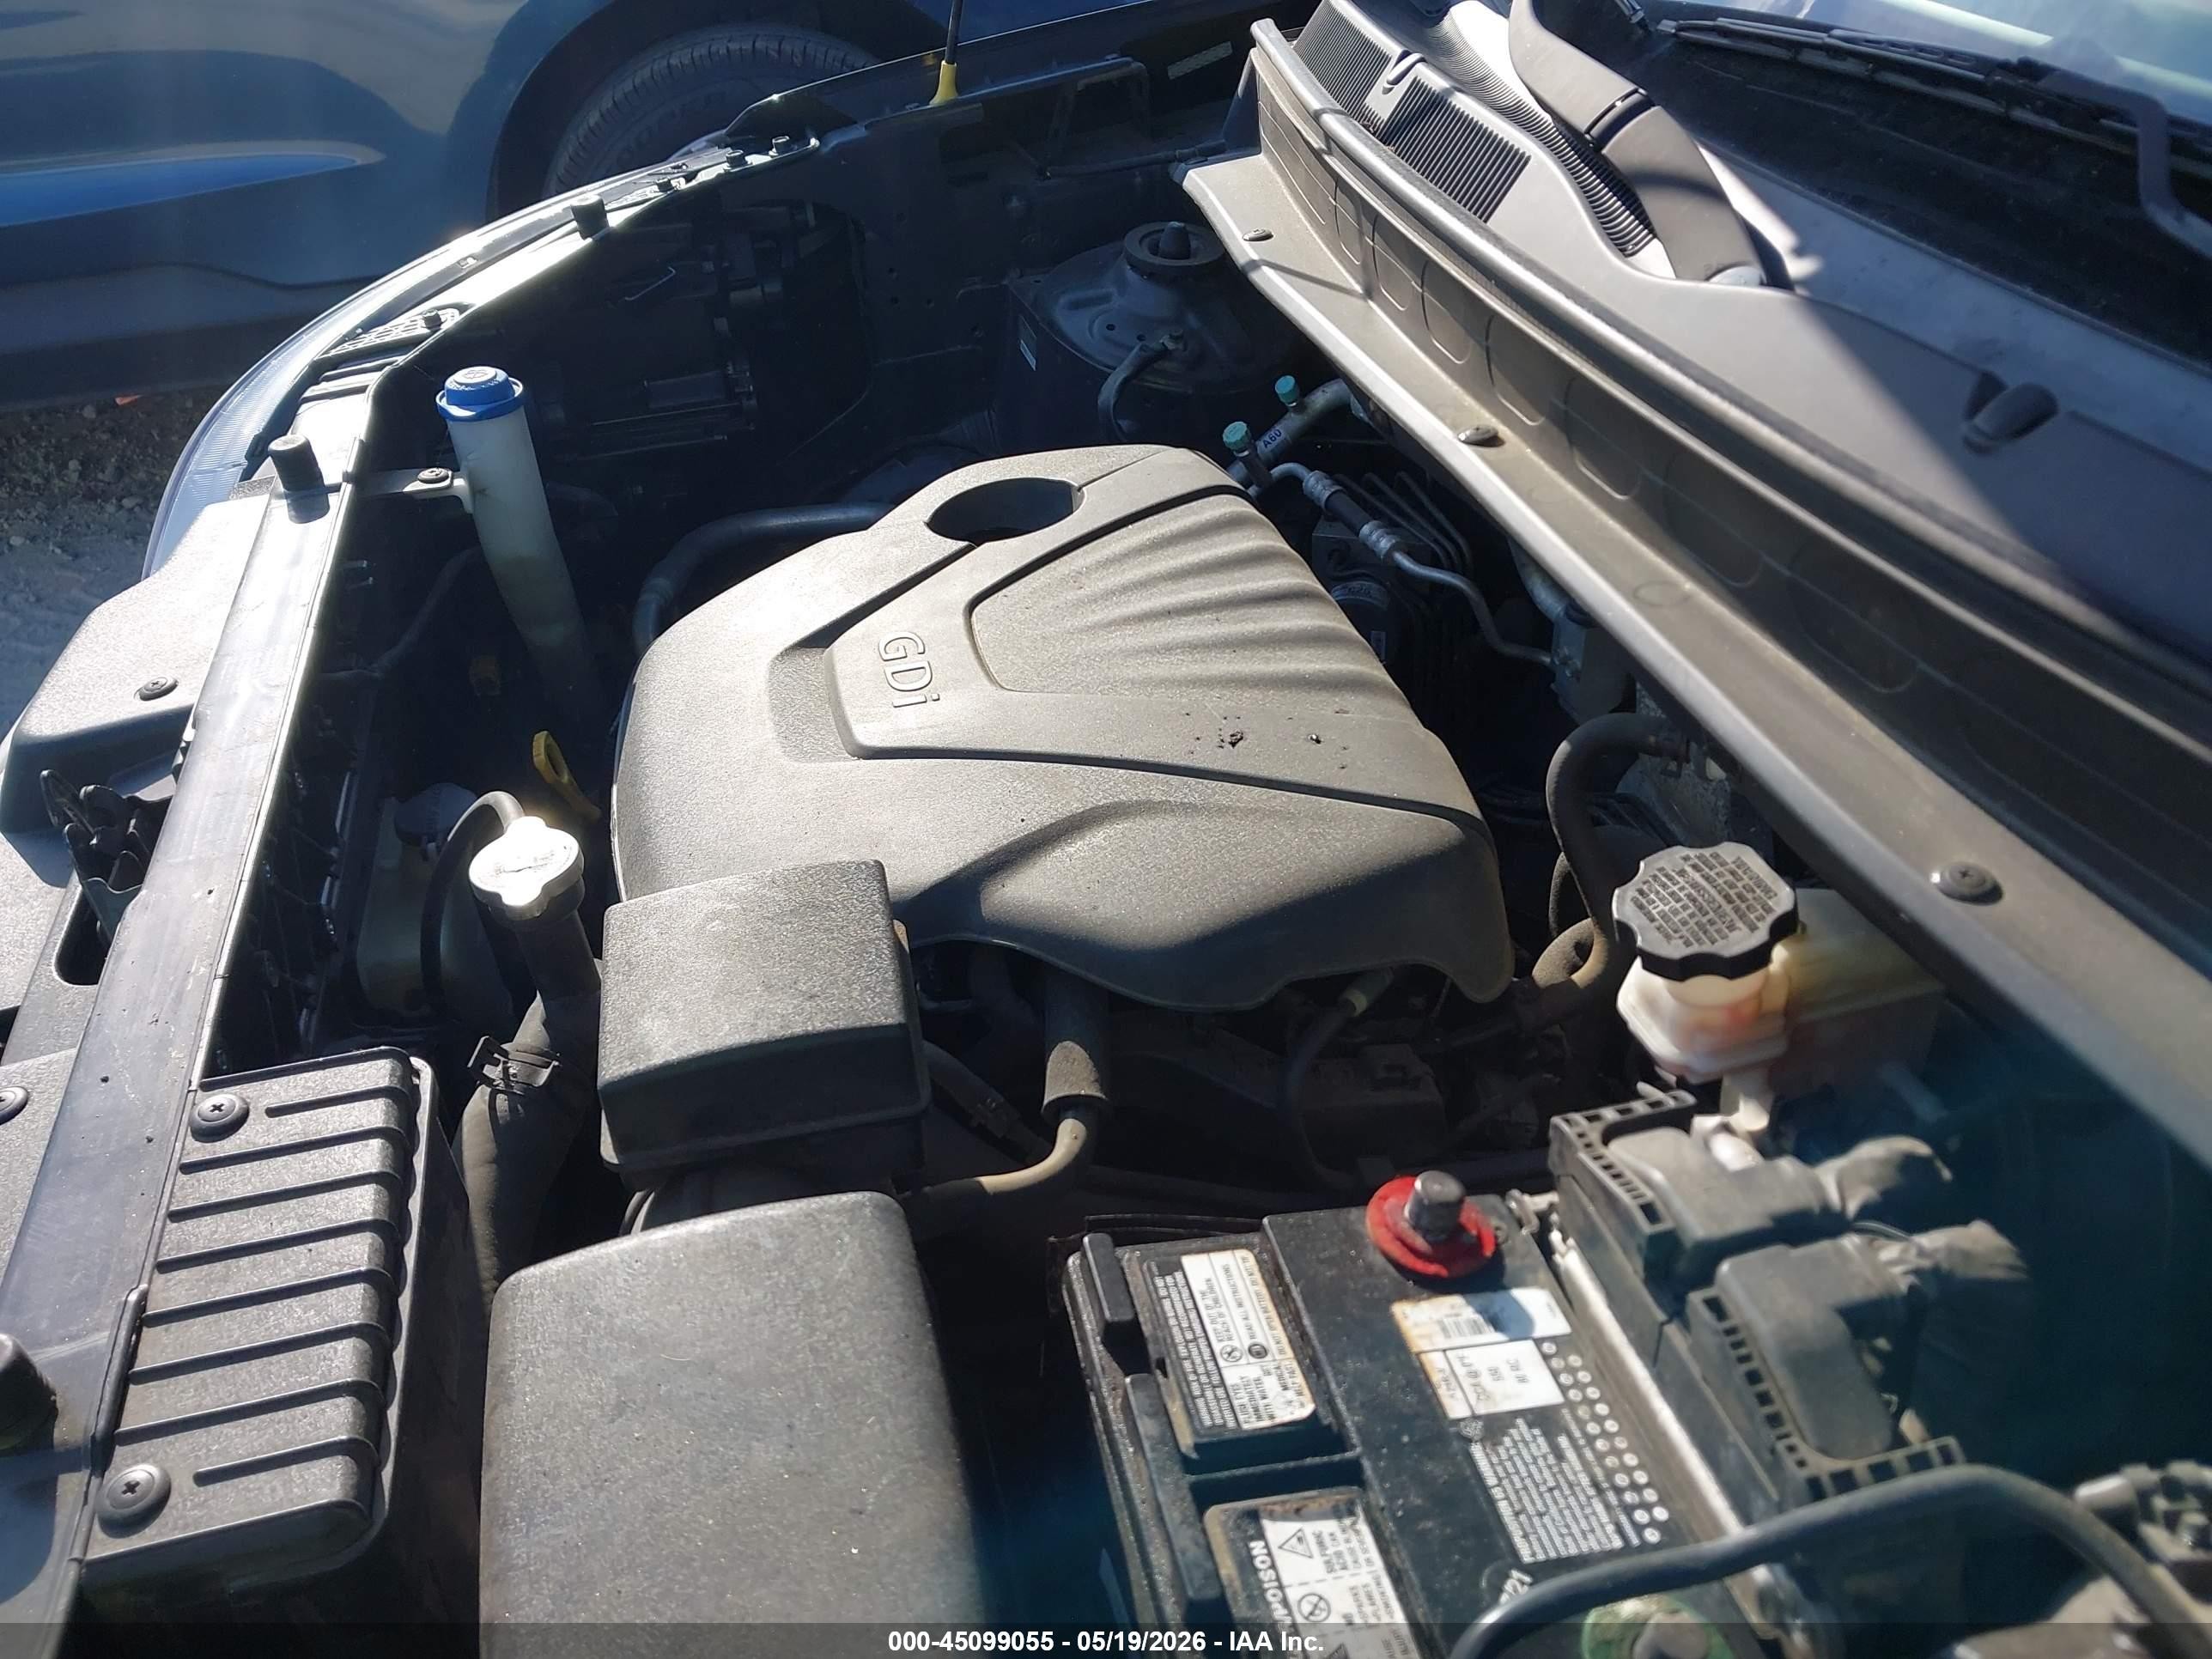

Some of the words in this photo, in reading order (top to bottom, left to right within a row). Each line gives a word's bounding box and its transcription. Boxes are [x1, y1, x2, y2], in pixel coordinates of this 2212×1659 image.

[1260, 427, 1283, 448] A60
[878, 631, 940, 709] GDi
[1489, 1486, 1506, 1499] 65
[1495, 1499, 1536, 1561] PROPOSITION
